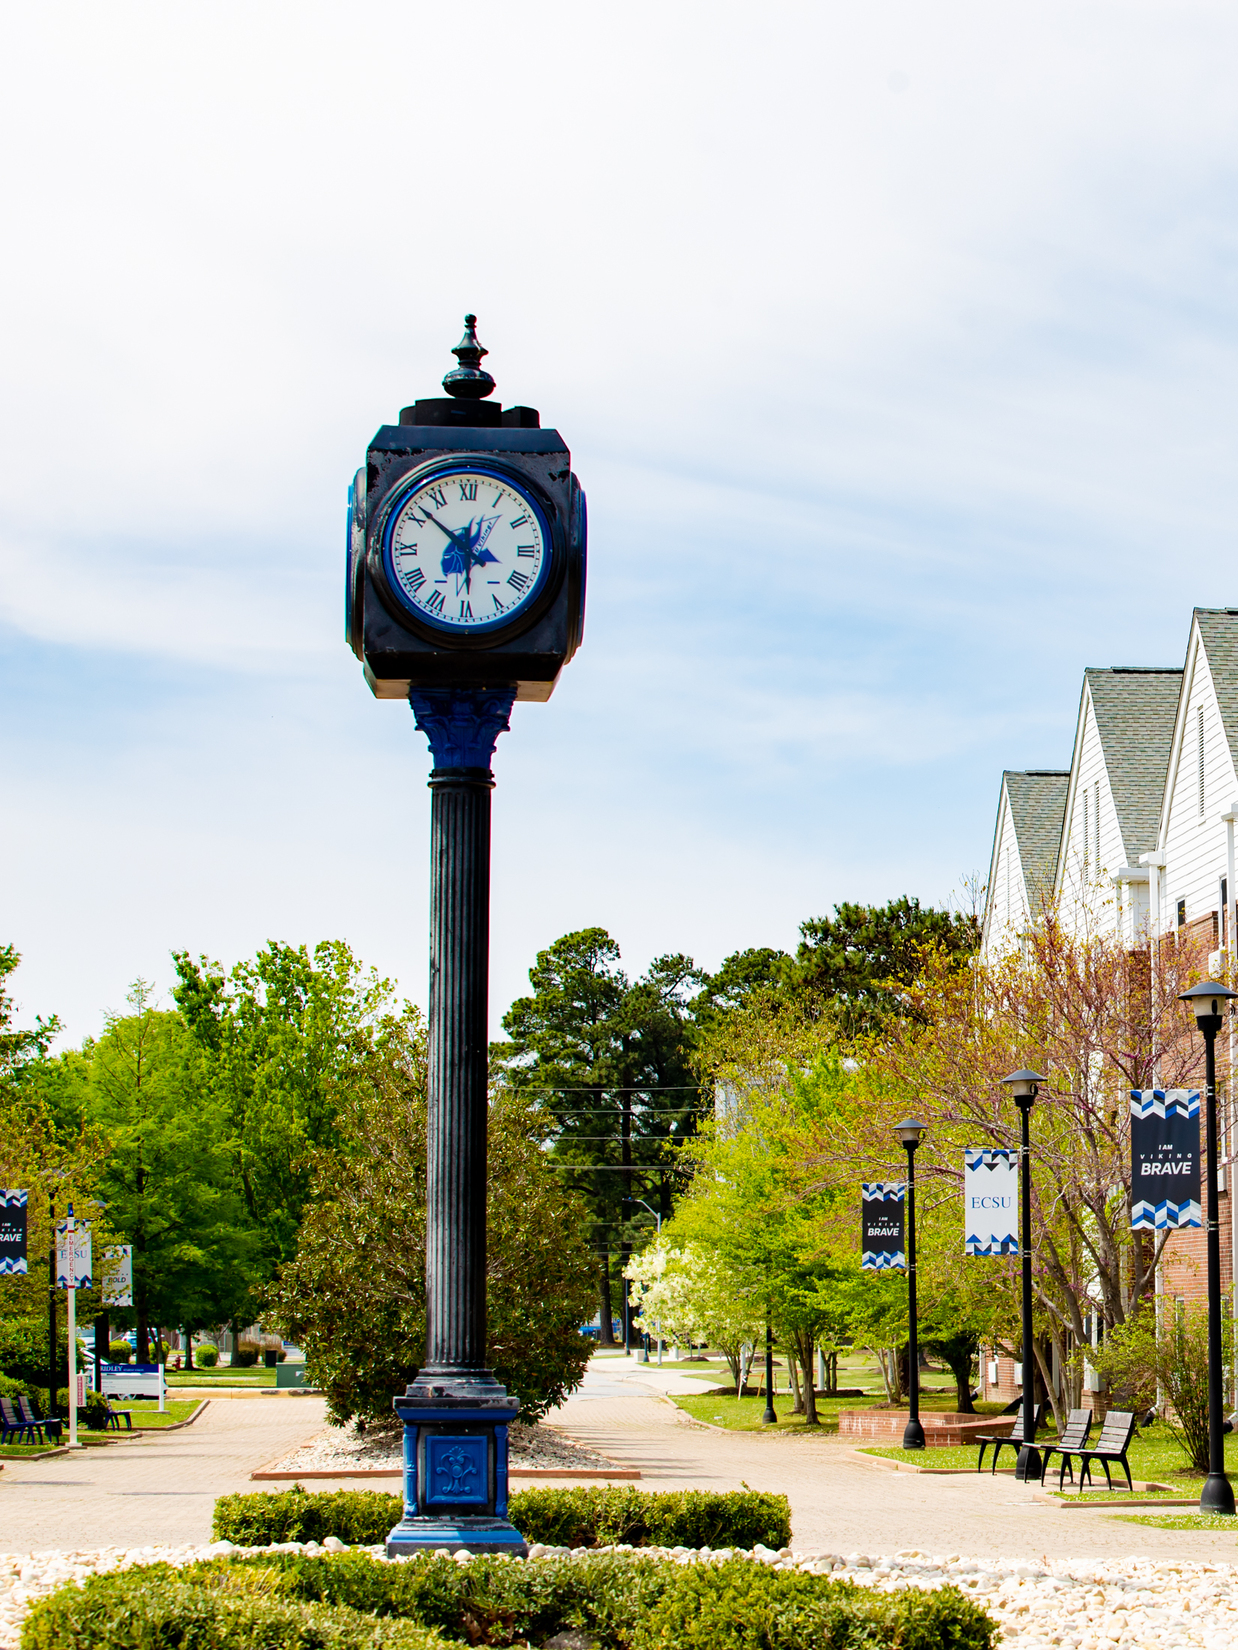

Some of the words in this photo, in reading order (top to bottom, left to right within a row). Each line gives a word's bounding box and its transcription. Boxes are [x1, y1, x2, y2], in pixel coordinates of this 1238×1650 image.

[429, 490, 448, 510] XI
[459, 484, 478, 501] XII
[491, 492, 504, 508] I
[408, 512, 426, 528] X
[509, 515, 528, 530] II
[399, 542, 418, 556] IX
[517, 545, 535, 558] III
[404, 567, 427, 593] VIII
[506, 569, 530, 592] IIII
[425, 589, 446, 612] VII
[492, 593, 504, 611] V
[459, 600, 474, 618] VI
[1140, 1162, 1192, 1175] BRAVE
[971, 1196, 1011, 1209] ECSU
[868, 1228, 900, 1237] BRAVE
[60, 1250, 88, 1259] ESU
